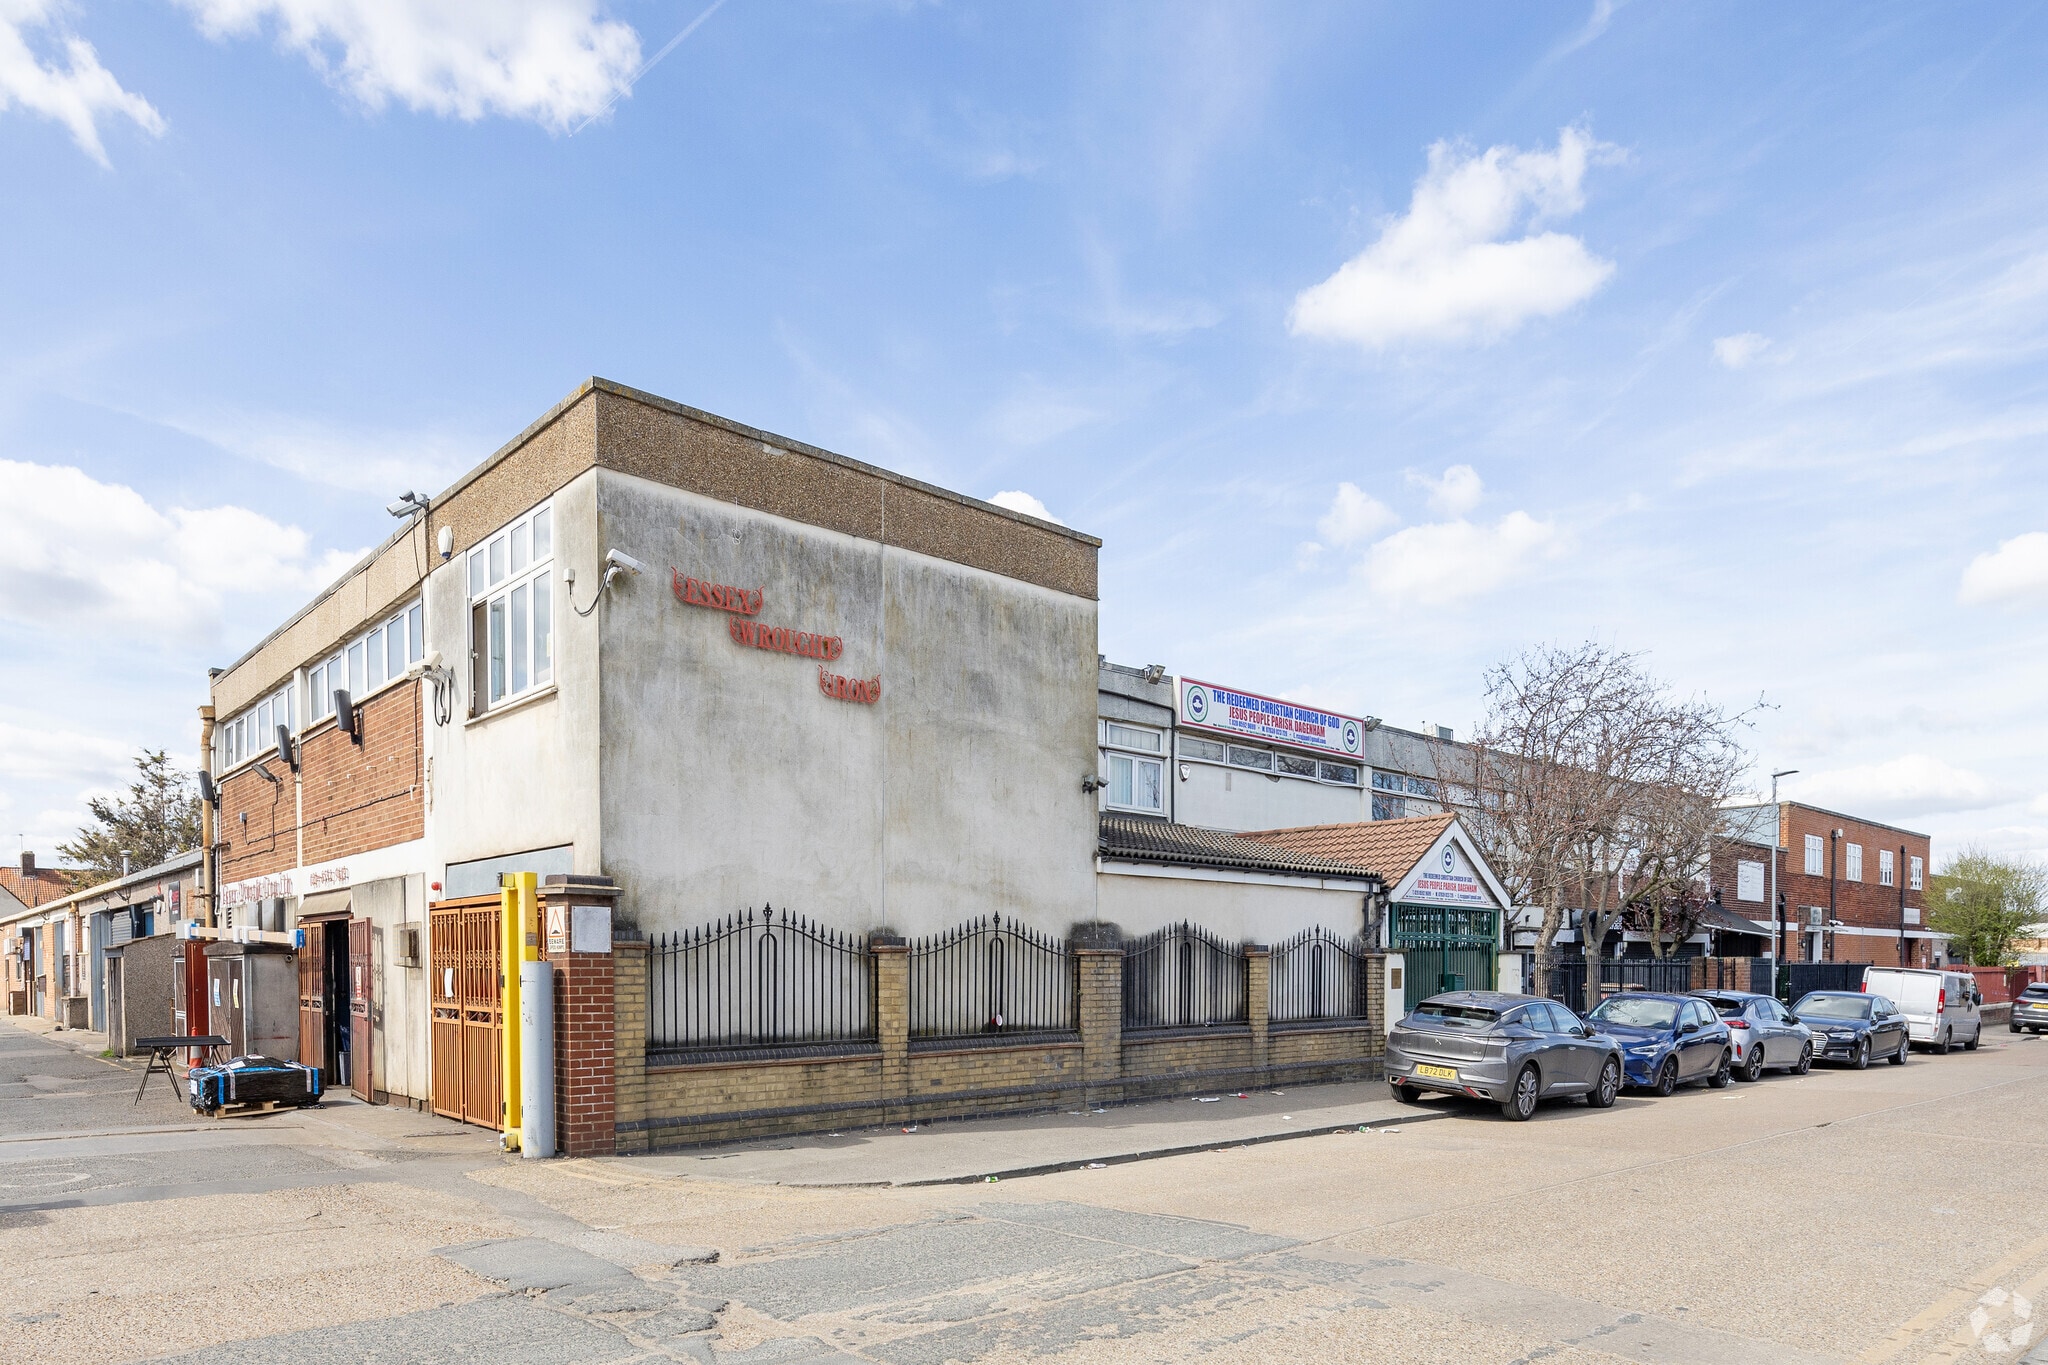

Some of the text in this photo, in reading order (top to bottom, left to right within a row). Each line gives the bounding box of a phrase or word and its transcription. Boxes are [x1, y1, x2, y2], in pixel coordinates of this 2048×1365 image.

[686, 577, 754, 614] ESSEX
[739, 619, 835, 660] WROUGHT
[829, 674, 872, 703] IRON
[1212, 690, 1340, 729] THE REDEEMED CHRISTIAN CHURCH OF GOD
[1229, 706, 1248, 722] JESUS
[1248, 710, 1271, 727] PEOPLE
[1271, 716, 1294, 732] PARISH,
[1294, 720, 1326, 738] DAGENHAM
[1417, 879, 1429, 889] JESUS
[1429, 880, 1443, 890] PEOPLE
[1457, 883, 1478, 893] DAGENHAM
[1420, 1066, 1438, 1075] LB72
